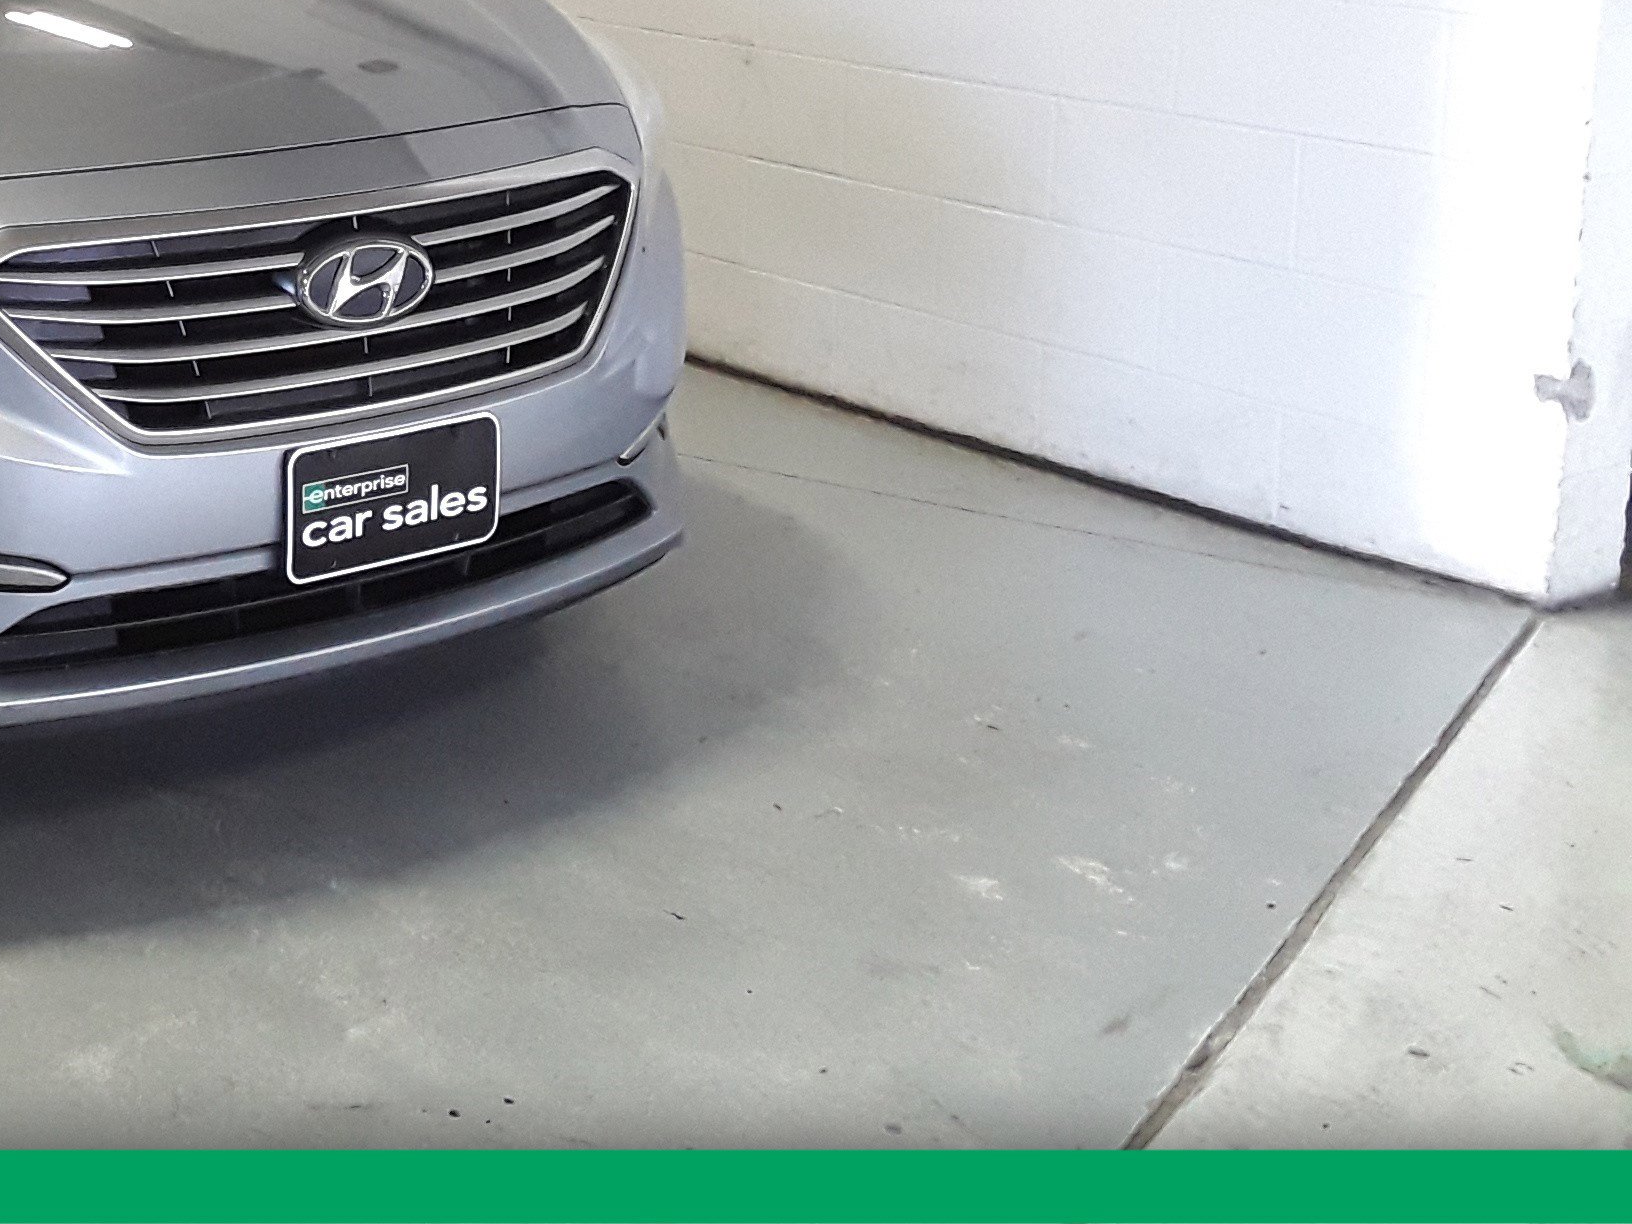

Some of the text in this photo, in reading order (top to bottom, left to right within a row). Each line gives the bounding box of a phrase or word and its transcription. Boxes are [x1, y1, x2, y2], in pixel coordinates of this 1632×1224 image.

[305, 474, 406, 504] enterprise
[302, 484, 488, 548] car sales
